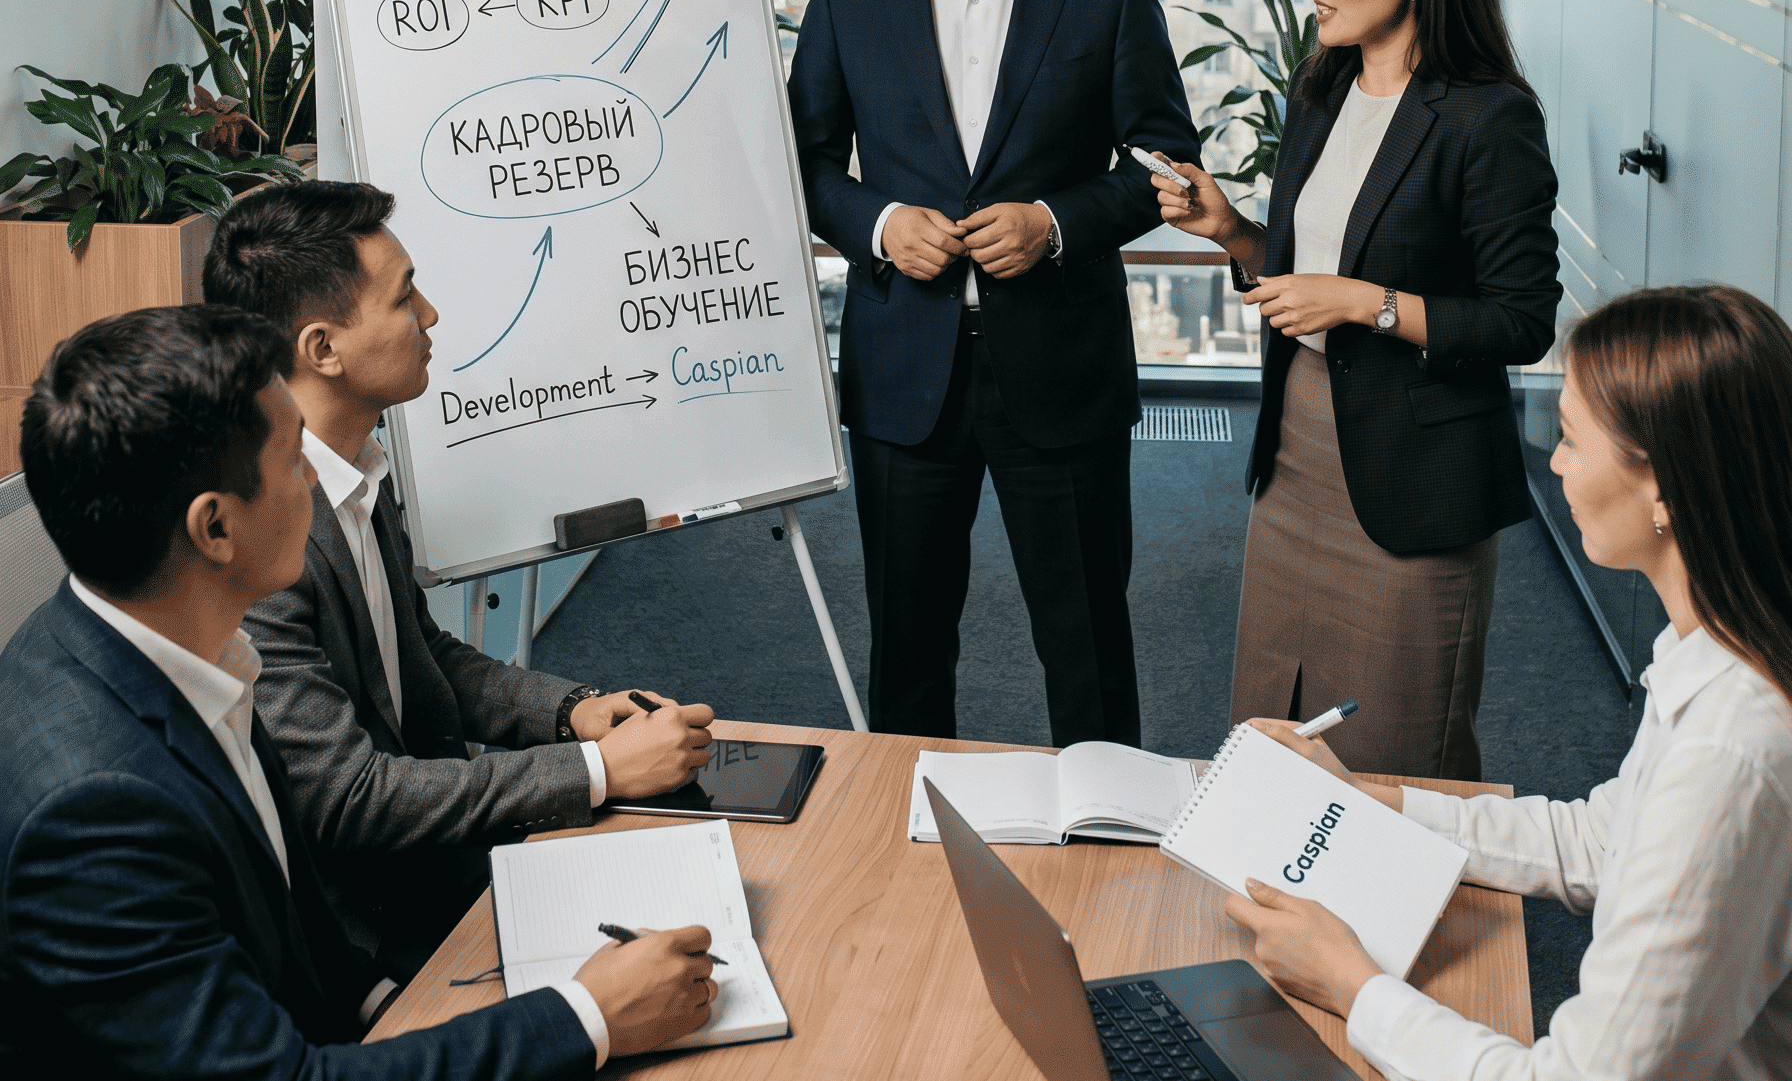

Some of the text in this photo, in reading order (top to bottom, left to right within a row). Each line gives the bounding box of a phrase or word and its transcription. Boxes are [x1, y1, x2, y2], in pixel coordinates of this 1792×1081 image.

[449, 97, 636, 156] КАДРОВЫЙ
[488, 153, 622, 200] РЕЗЕРВ
[624, 237, 756, 286] БИЗНЕС
[619, 281, 786, 334] ОБУЧЕНИЕ
[440, 345, 785, 426] Development Caspian
[1282, 802, 1346, 884] Caspian
